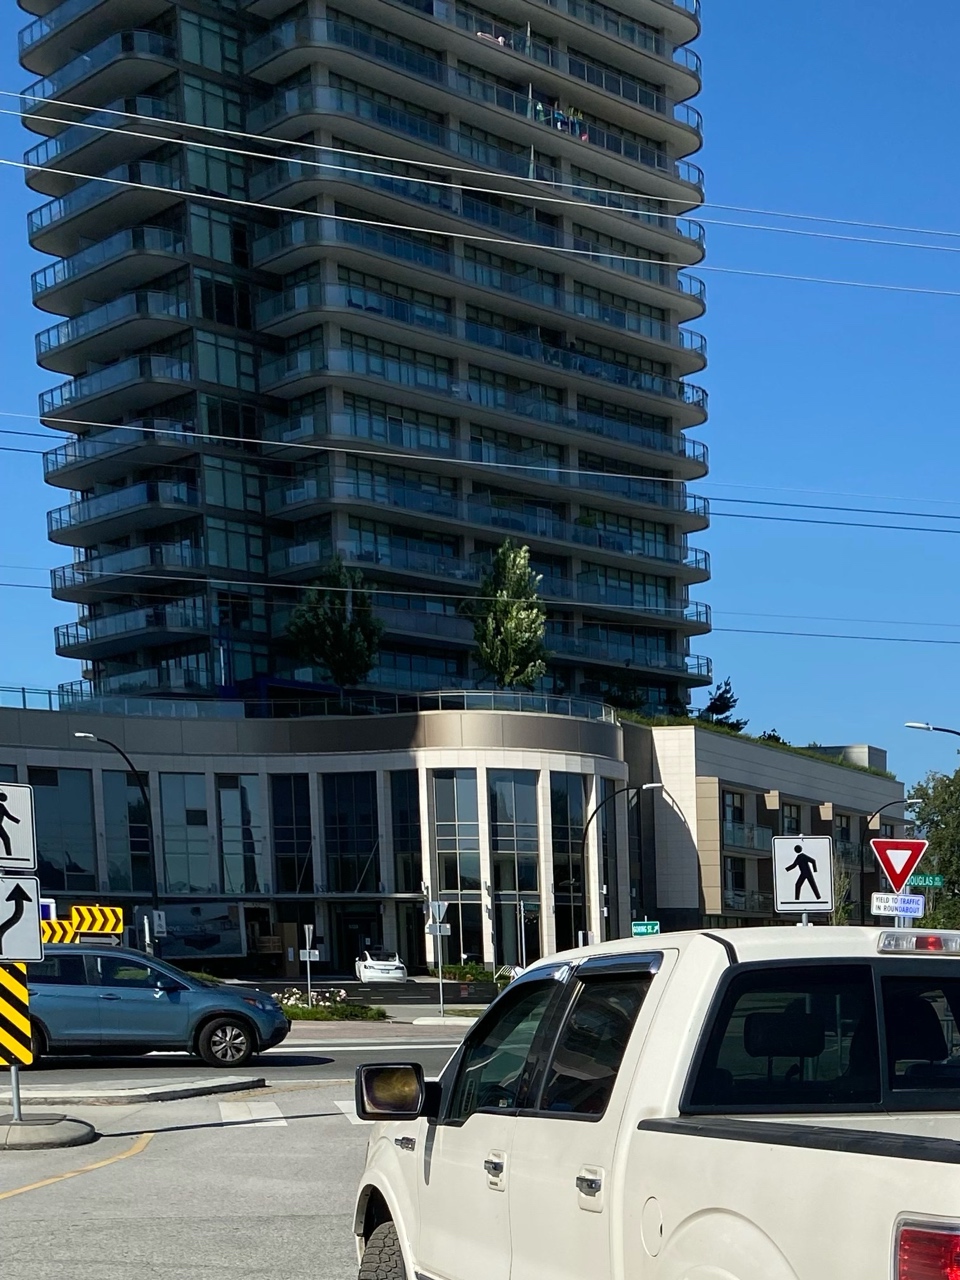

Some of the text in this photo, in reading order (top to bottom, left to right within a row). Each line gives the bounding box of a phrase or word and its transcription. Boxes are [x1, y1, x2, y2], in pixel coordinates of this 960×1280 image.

[906, 876, 934, 886] DOUGLAS
[875, 896, 890, 904] YIELD
[900, 897, 920, 905] TRAFFIC
[883, 905, 920, 914] ROUNDABOUT
